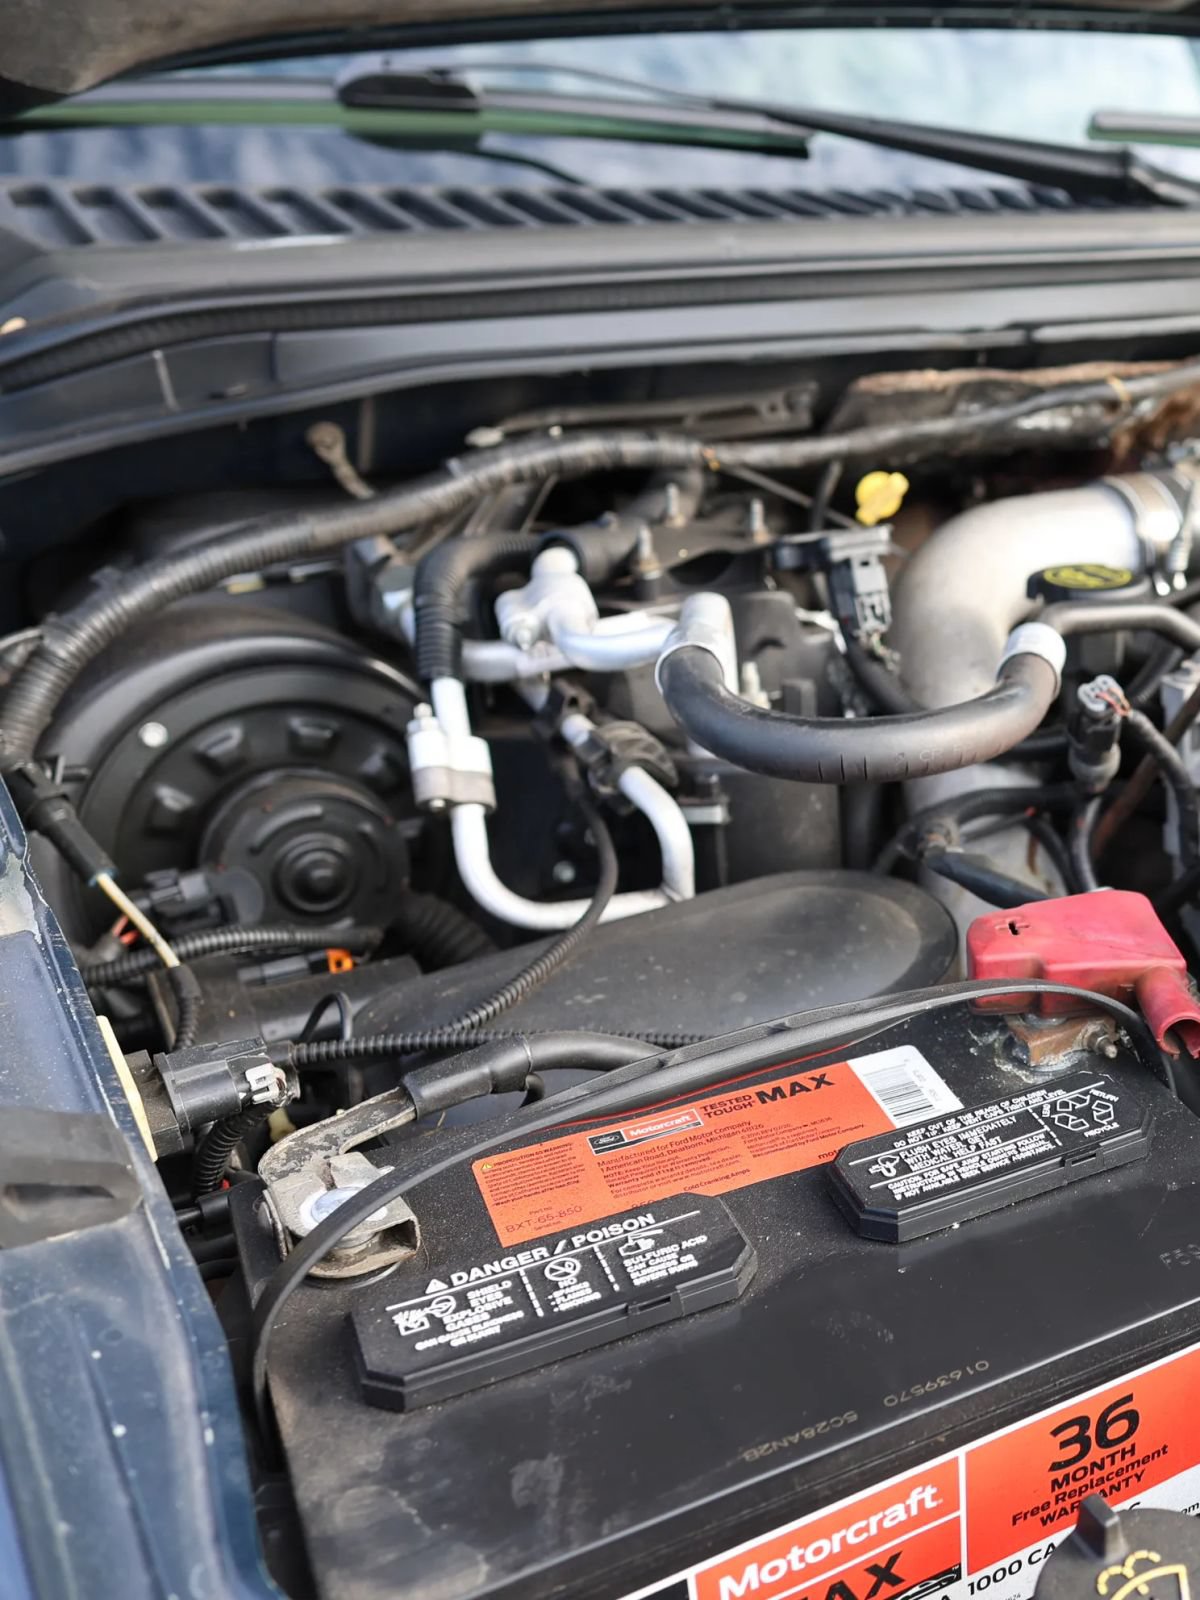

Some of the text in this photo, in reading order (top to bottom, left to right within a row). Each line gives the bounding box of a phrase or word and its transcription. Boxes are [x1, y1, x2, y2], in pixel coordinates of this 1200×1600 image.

[699, 1094, 753, 1112] TESTED
[753, 1072, 835, 1104] MAX
[1088, 1088, 1119, 1103] RETURN
[628, 1114, 692, 1136] Motorcraft
[892, 1140, 906, 1148] DO
[906, 1134, 924, 1144] NOT
[941, 1122, 963, 1132] KEEP
[963, 1116, 983, 1126] VENT
[982, 1108, 1004, 1119] CAPS
[1004, 1101, 1027, 1112] TIGHT
[1027, 1095, 1044, 1105] AND
[1043, 1088, 1066, 1099] LEVEL
[905, 1127, 927, 1137] KEEP
[926, 1121, 944, 1130] OUT
[956, 1112, 974, 1121] THE
[973, 1103, 1001, 1116] REACH
[999, 1100, 1011, 1108] OF
[1010, 1088, 1047, 1104] CHILDREN
[597, 1146, 656, 1167] Manufactured
[656, 1143, 668, 1151] for
[668, 1137, 689, 1147] Ford
[688, 1130, 714, 1142] Motor
[713, 1120, 752, 1135] Company
[898, 1115, 1018, 1159] FLUSH EYES IMMEDIATELY
[1083, 1121, 1120, 1138] RECYCLE
[604, 1157, 643, 1172] American
[643, 1151, 666, 1161] Road,
[705, 1130, 741, 1143] Michigan
[903, 1152, 930, 1165] WITH
[966, 1134, 986, 1144] GET
[908, 1136, 1003, 1171] MEDICAL HELP FAST
[922, 1169, 940, 1178] FOR
[939, 1162, 960, 1172] SAFE
[980, 1143, 1016, 1159] STARTING
[1016, 1133, 1046, 1146] FOLLOW
[682, 1168, 750, 1191] Cold Cranking Amps
[902, 1187, 921, 1197] NOT
[504, 1204, 583, 1233] BXT-65-850
[449, 1211, 655, 1286] DANGER / POISON
[622, 1234, 708, 1267] SULFURIC ACID
[625, 1251, 678, 1273] CAN CAUSE
[678, 1253, 695, 1263] OR
[465, 1279, 513, 1300] SHIELD
[468, 1290, 504, 1307] EYES
[557, 1277, 578, 1289] NO
[441, 1295, 514, 1325] EXPLOSIVE
[443, 1311, 491, 1332] GASES
[884, 1359, 991, 1409] 01639570
[1048, 1393, 1139, 1472] 36
[1051, 1443, 1136, 1493] MONTH
[1012, 1444, 1168, 1526] Free Replacement
[1040, 1470, 1146, 1528] WARANTY
[718, 1484, 939, 1600] Motorcraft
[968, 1562, 1023, 1596] 1000
